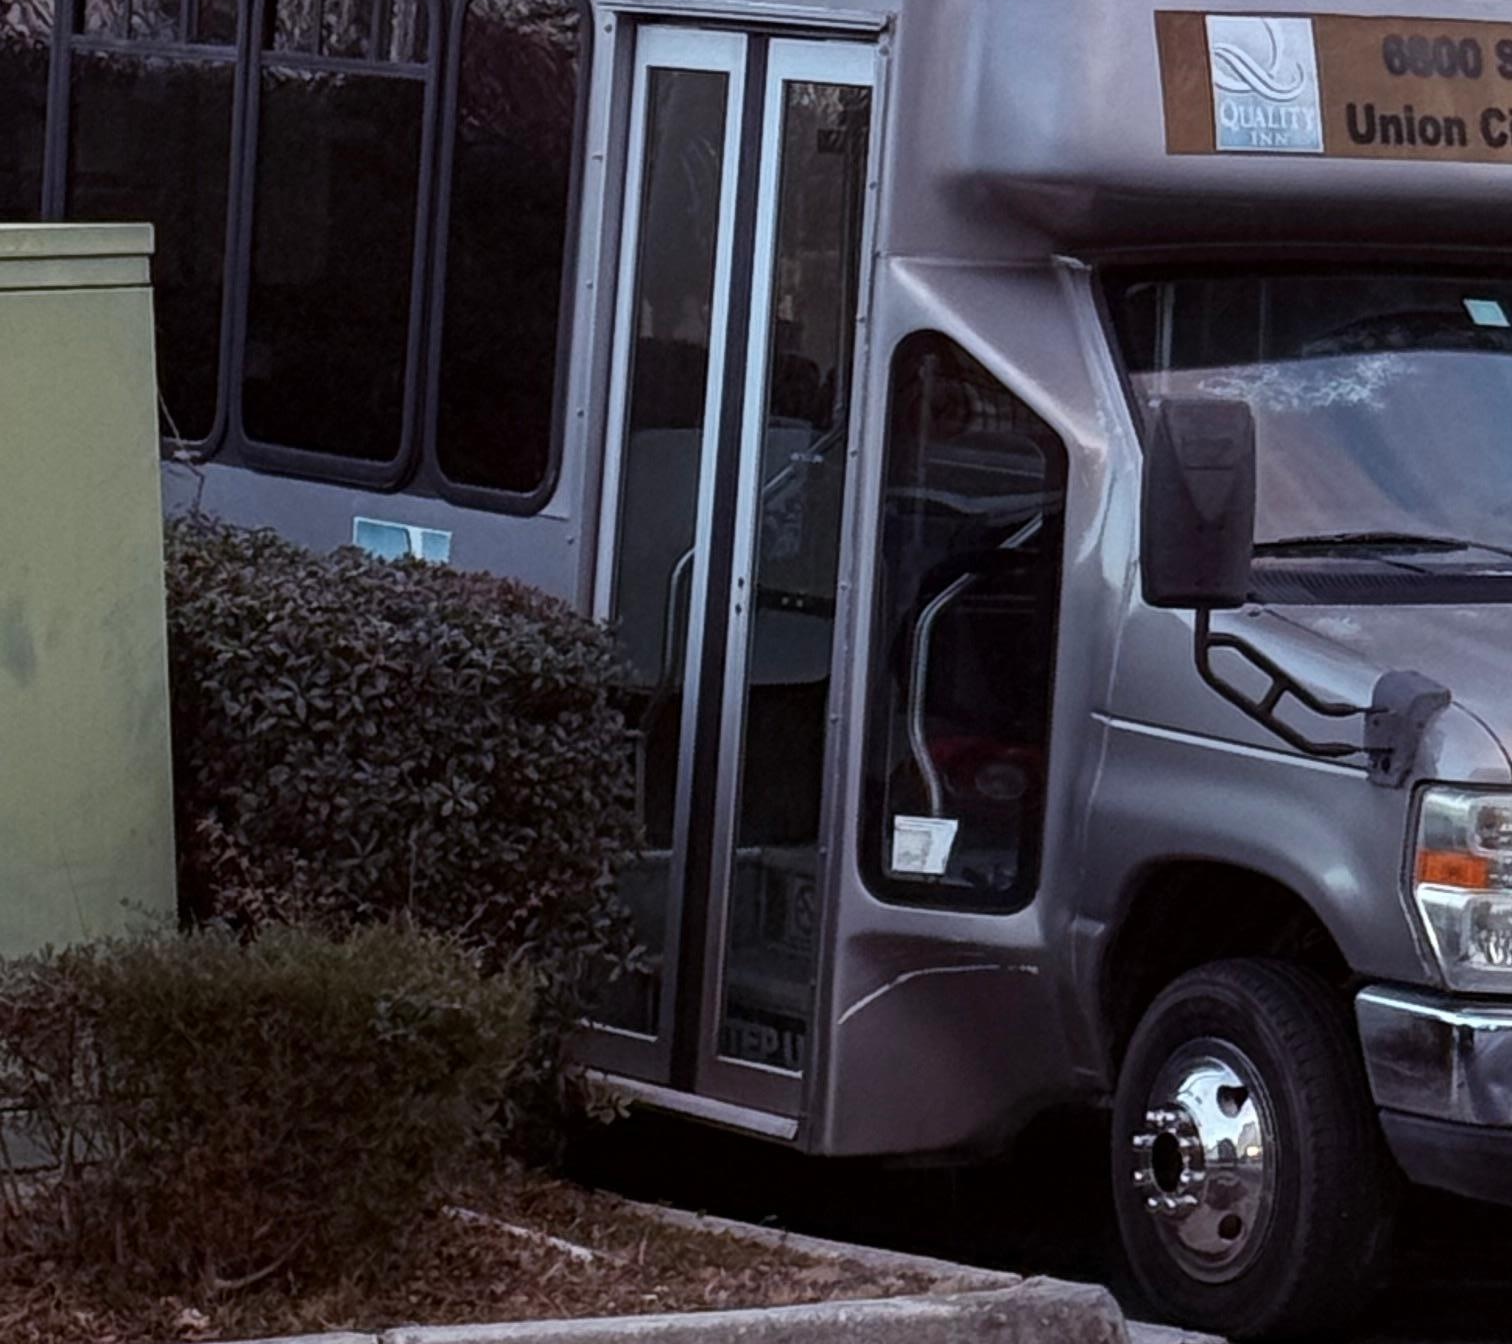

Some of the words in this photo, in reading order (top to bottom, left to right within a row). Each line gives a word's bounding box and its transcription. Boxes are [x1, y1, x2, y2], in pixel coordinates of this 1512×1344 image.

[1222, 98, 1316, 132] QUALITY
[1346, 102, 1467, 149] Union
[1250, 130, 1291, 147] INN
